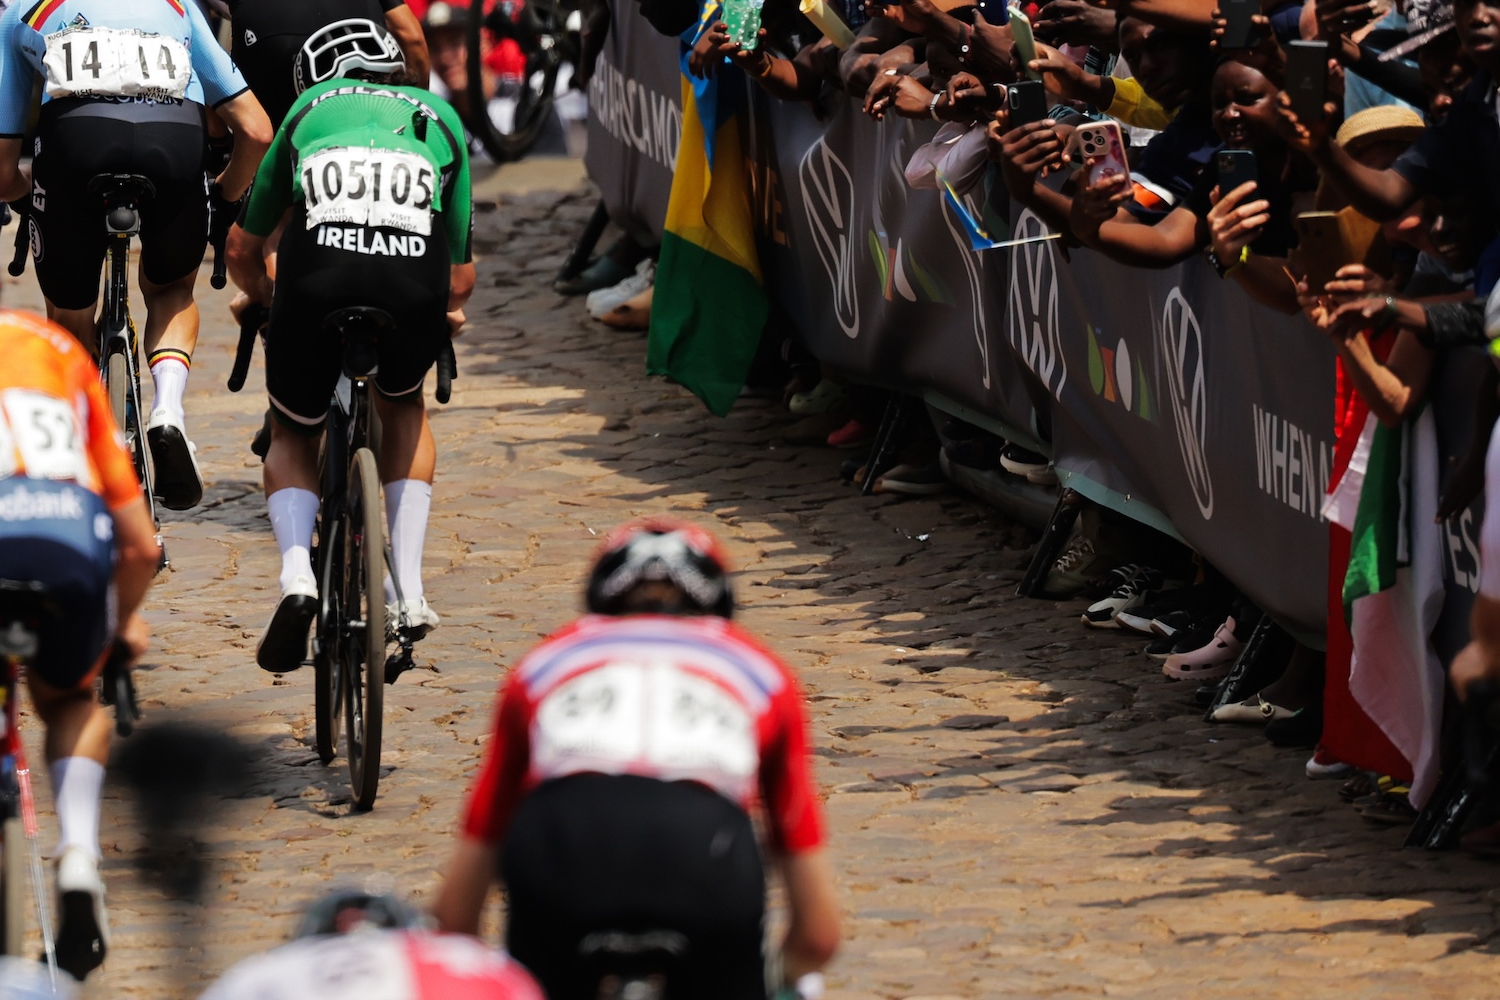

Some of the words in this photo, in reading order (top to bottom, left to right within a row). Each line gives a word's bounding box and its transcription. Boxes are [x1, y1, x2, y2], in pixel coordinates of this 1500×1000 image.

[62, 41, 102, 82] 14
[138, 44, 177, 80] 14
[312, 86, 439, 121] IRELAND
[32, 179, 47, 213] EY
[303, 160, 367, 208] 105
[371, 162, 433, 210] 105
[381, 218, 418, 231] RWANDA
[389, 212, 412, 221] VISIT
[316, 224, 427, 258] IRELAND
[1253, 403, 1316, 519] WHEN
